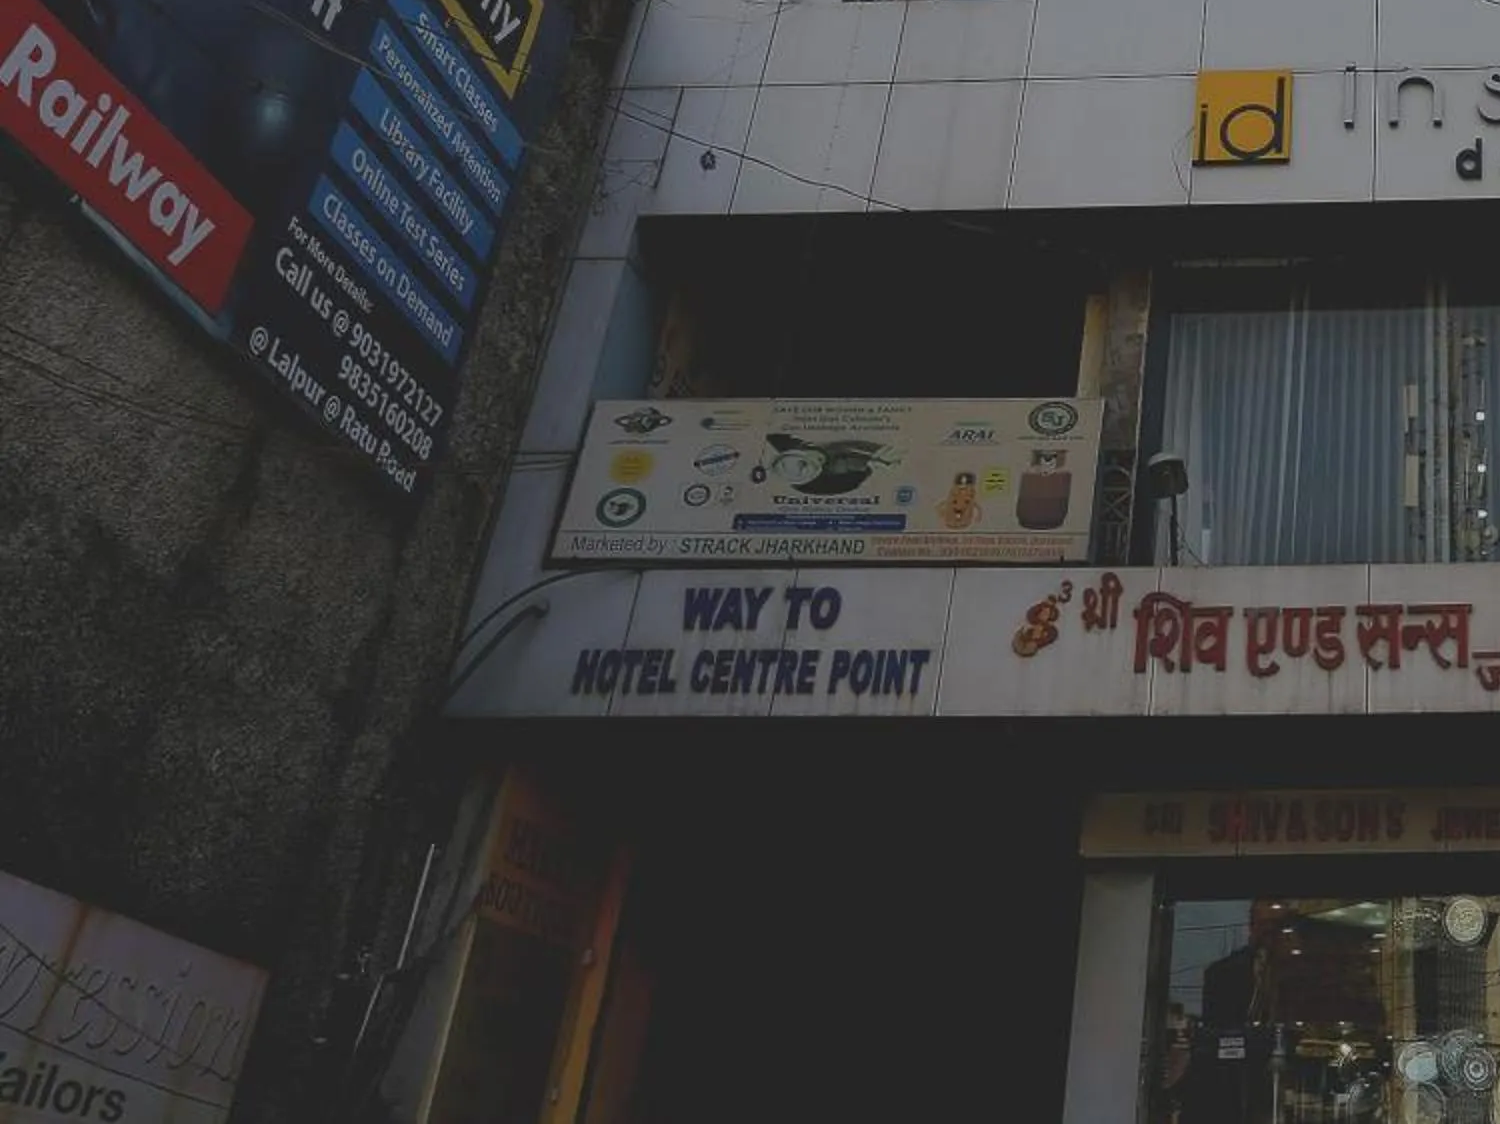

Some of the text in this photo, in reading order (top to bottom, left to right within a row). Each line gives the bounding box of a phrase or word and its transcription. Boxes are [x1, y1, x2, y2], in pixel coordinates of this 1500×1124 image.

[416, 12, 499, 133] Smart Classes
[1, 23, 216, 266] Railway
[380, 108, 475, 235] Library Facility
[352, 147, 466, 292] Online Test Series
[275, 246, 313, 297] Call
[310, 286, 335, 320] us
[332, 309, 350, 337] @
[323, 193, 456, 348] Classes on Demand
[250, 326, 270, 356] @
[266, 336, 328, 407] Lalpur
[773, 494, 881, 506] Universal
[571, 535, 646, 554] Marketed
[646, 536, 670, 557] by
[679, 537, 753, 555] STRACK
[753, 537, 866, 556] JHARKHAND
[683, 587, 843, 632] WAY TO
[1081, 571, 1124, 630] श्री
[1133, 591, 1234, 674] शिव
[1244, 606, 1348, 677] एण्ड
[1355, 603, 1473, 670] सन्स
[570, 650, 931, 696] HOTEL CENTRE POINT
[0, 1048, 127, 1124] ailors
